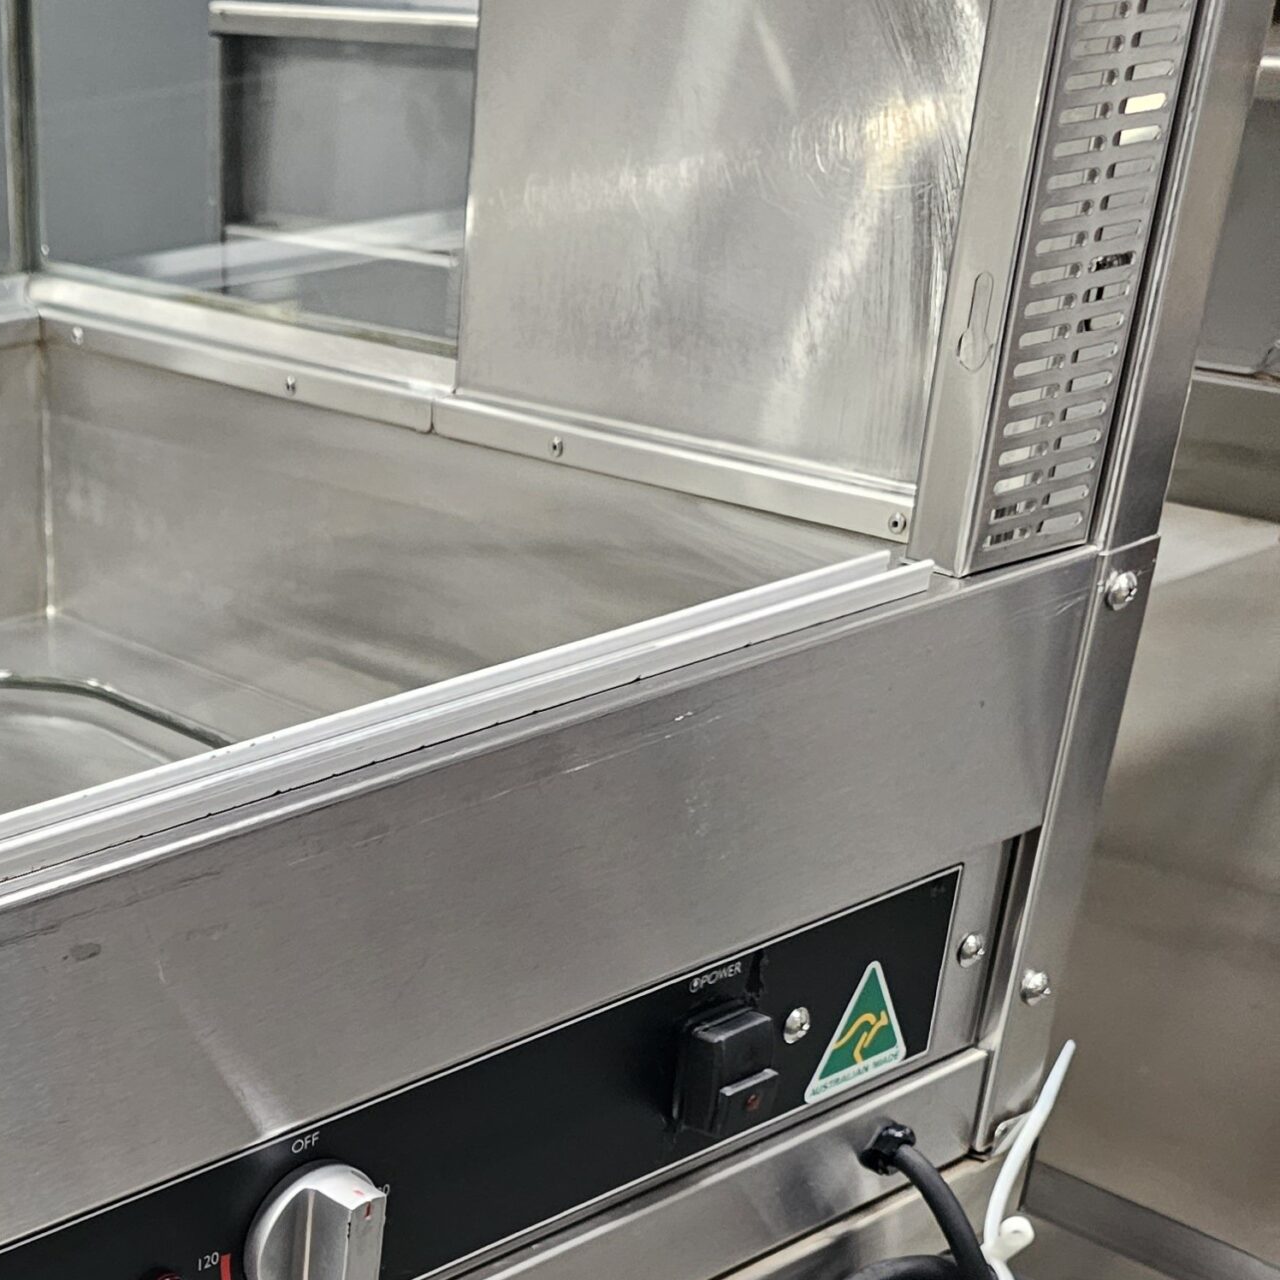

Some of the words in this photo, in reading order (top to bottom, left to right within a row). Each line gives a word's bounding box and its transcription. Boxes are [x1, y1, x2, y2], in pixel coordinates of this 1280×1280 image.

[700, 961, 742, 988] POWER
[291, 1131, 320, 1154] OFF
[198, 1251, 220, 1271] 120
